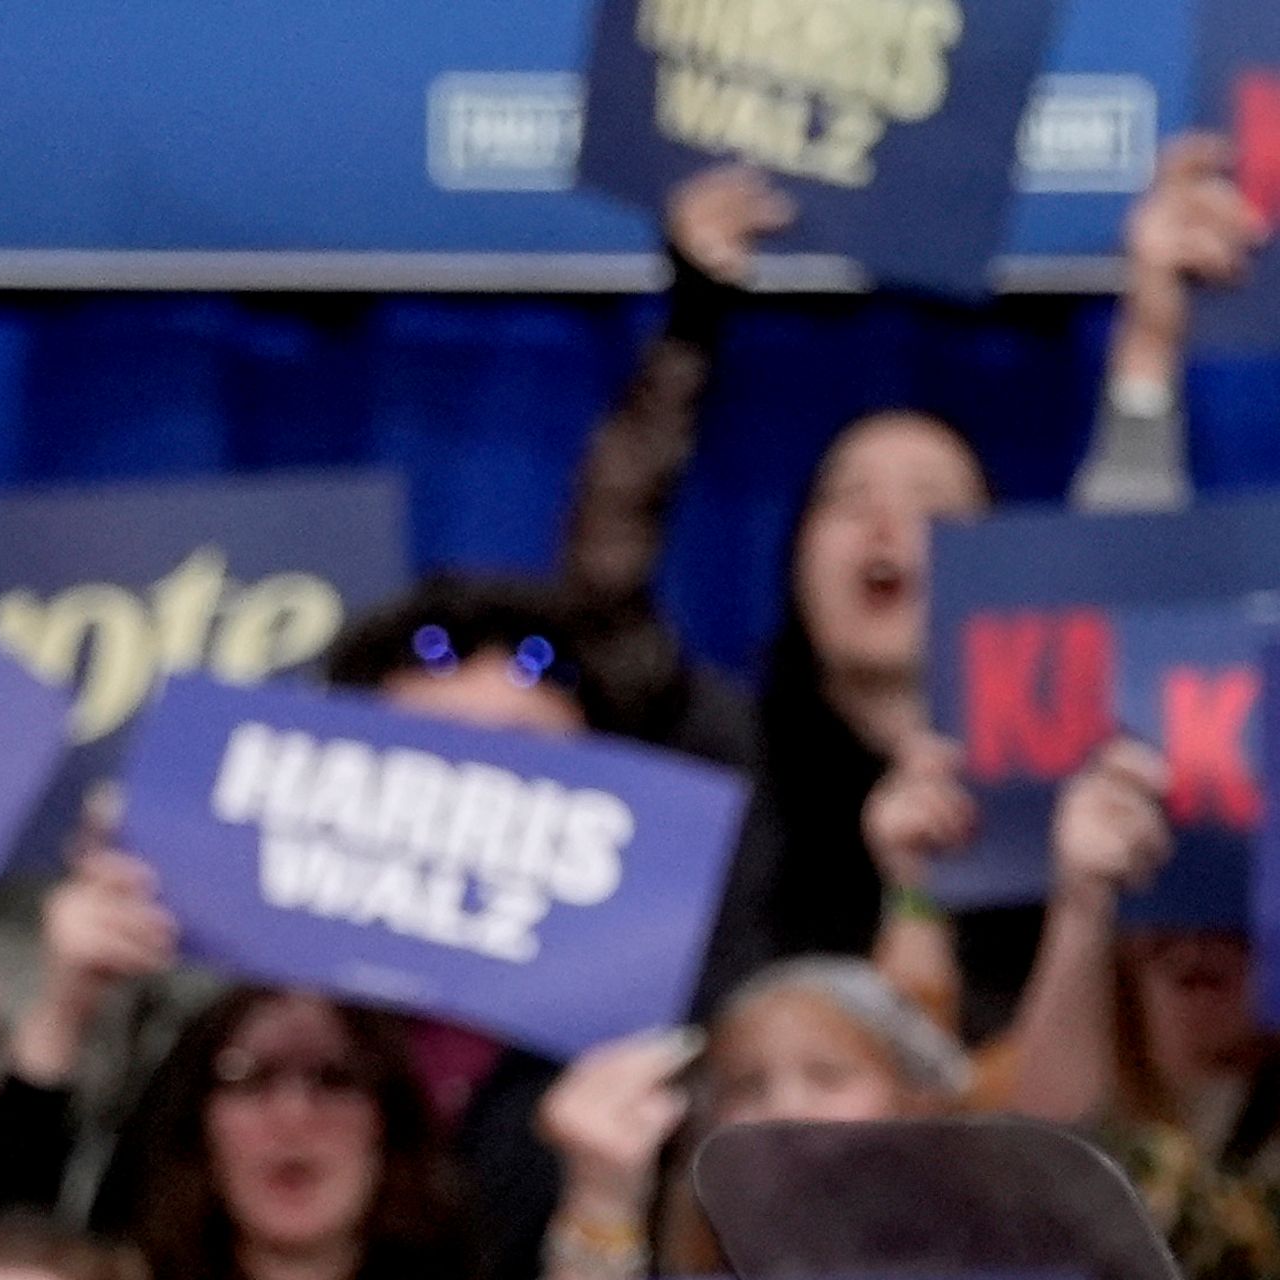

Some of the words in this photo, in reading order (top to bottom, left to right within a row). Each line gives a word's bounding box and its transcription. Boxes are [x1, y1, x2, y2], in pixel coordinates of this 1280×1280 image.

[653, 68, 878, 188] WALZ
[213, 720, 636, 907] HARRIS
[258, 828, 555, 965] WALZ
